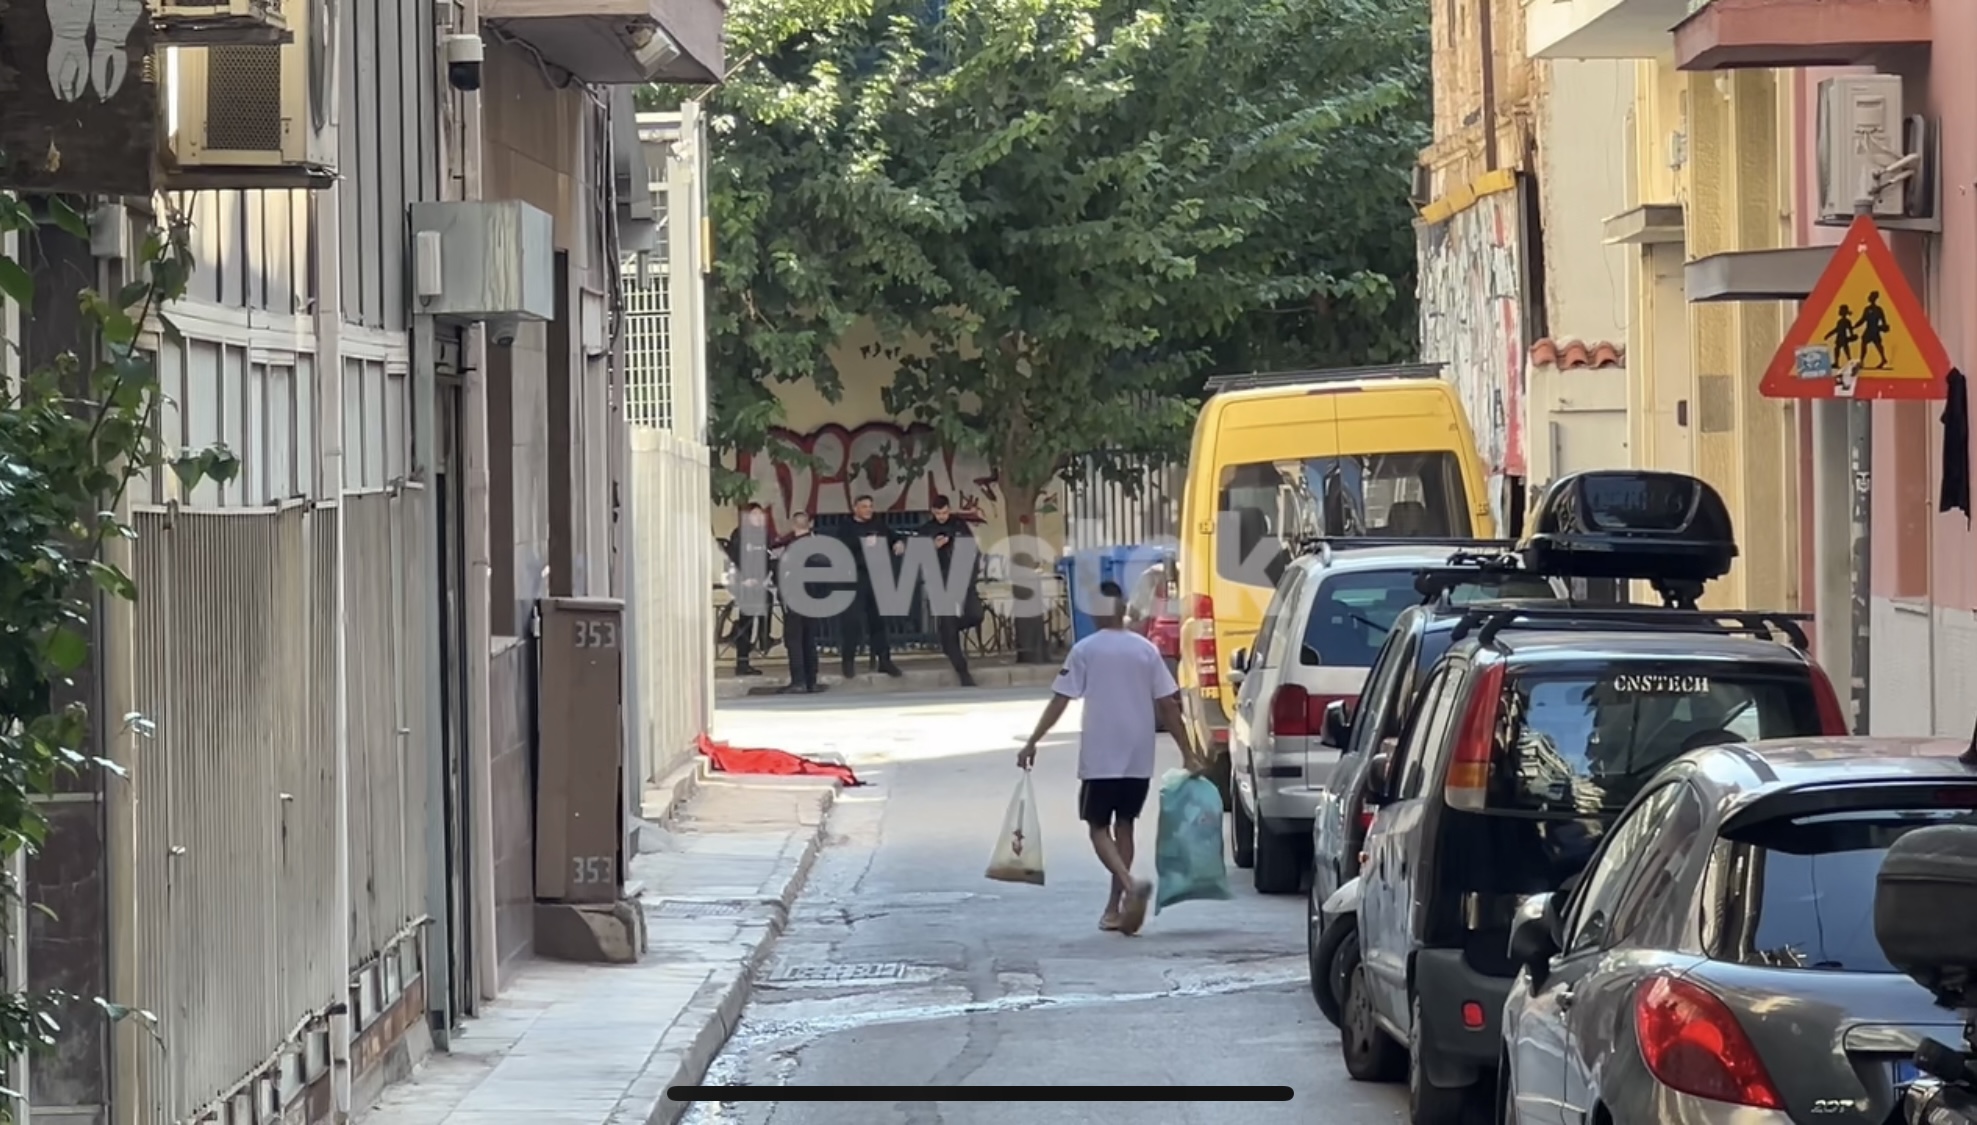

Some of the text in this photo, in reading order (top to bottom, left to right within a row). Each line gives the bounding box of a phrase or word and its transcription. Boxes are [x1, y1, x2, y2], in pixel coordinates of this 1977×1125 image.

[575, 621, 616, 648] 353
[1613, 674, 1710, 693] CNSTECH
[573, 856, 613, 884] 353
[1811, 1099, 1855, 1114] 207
